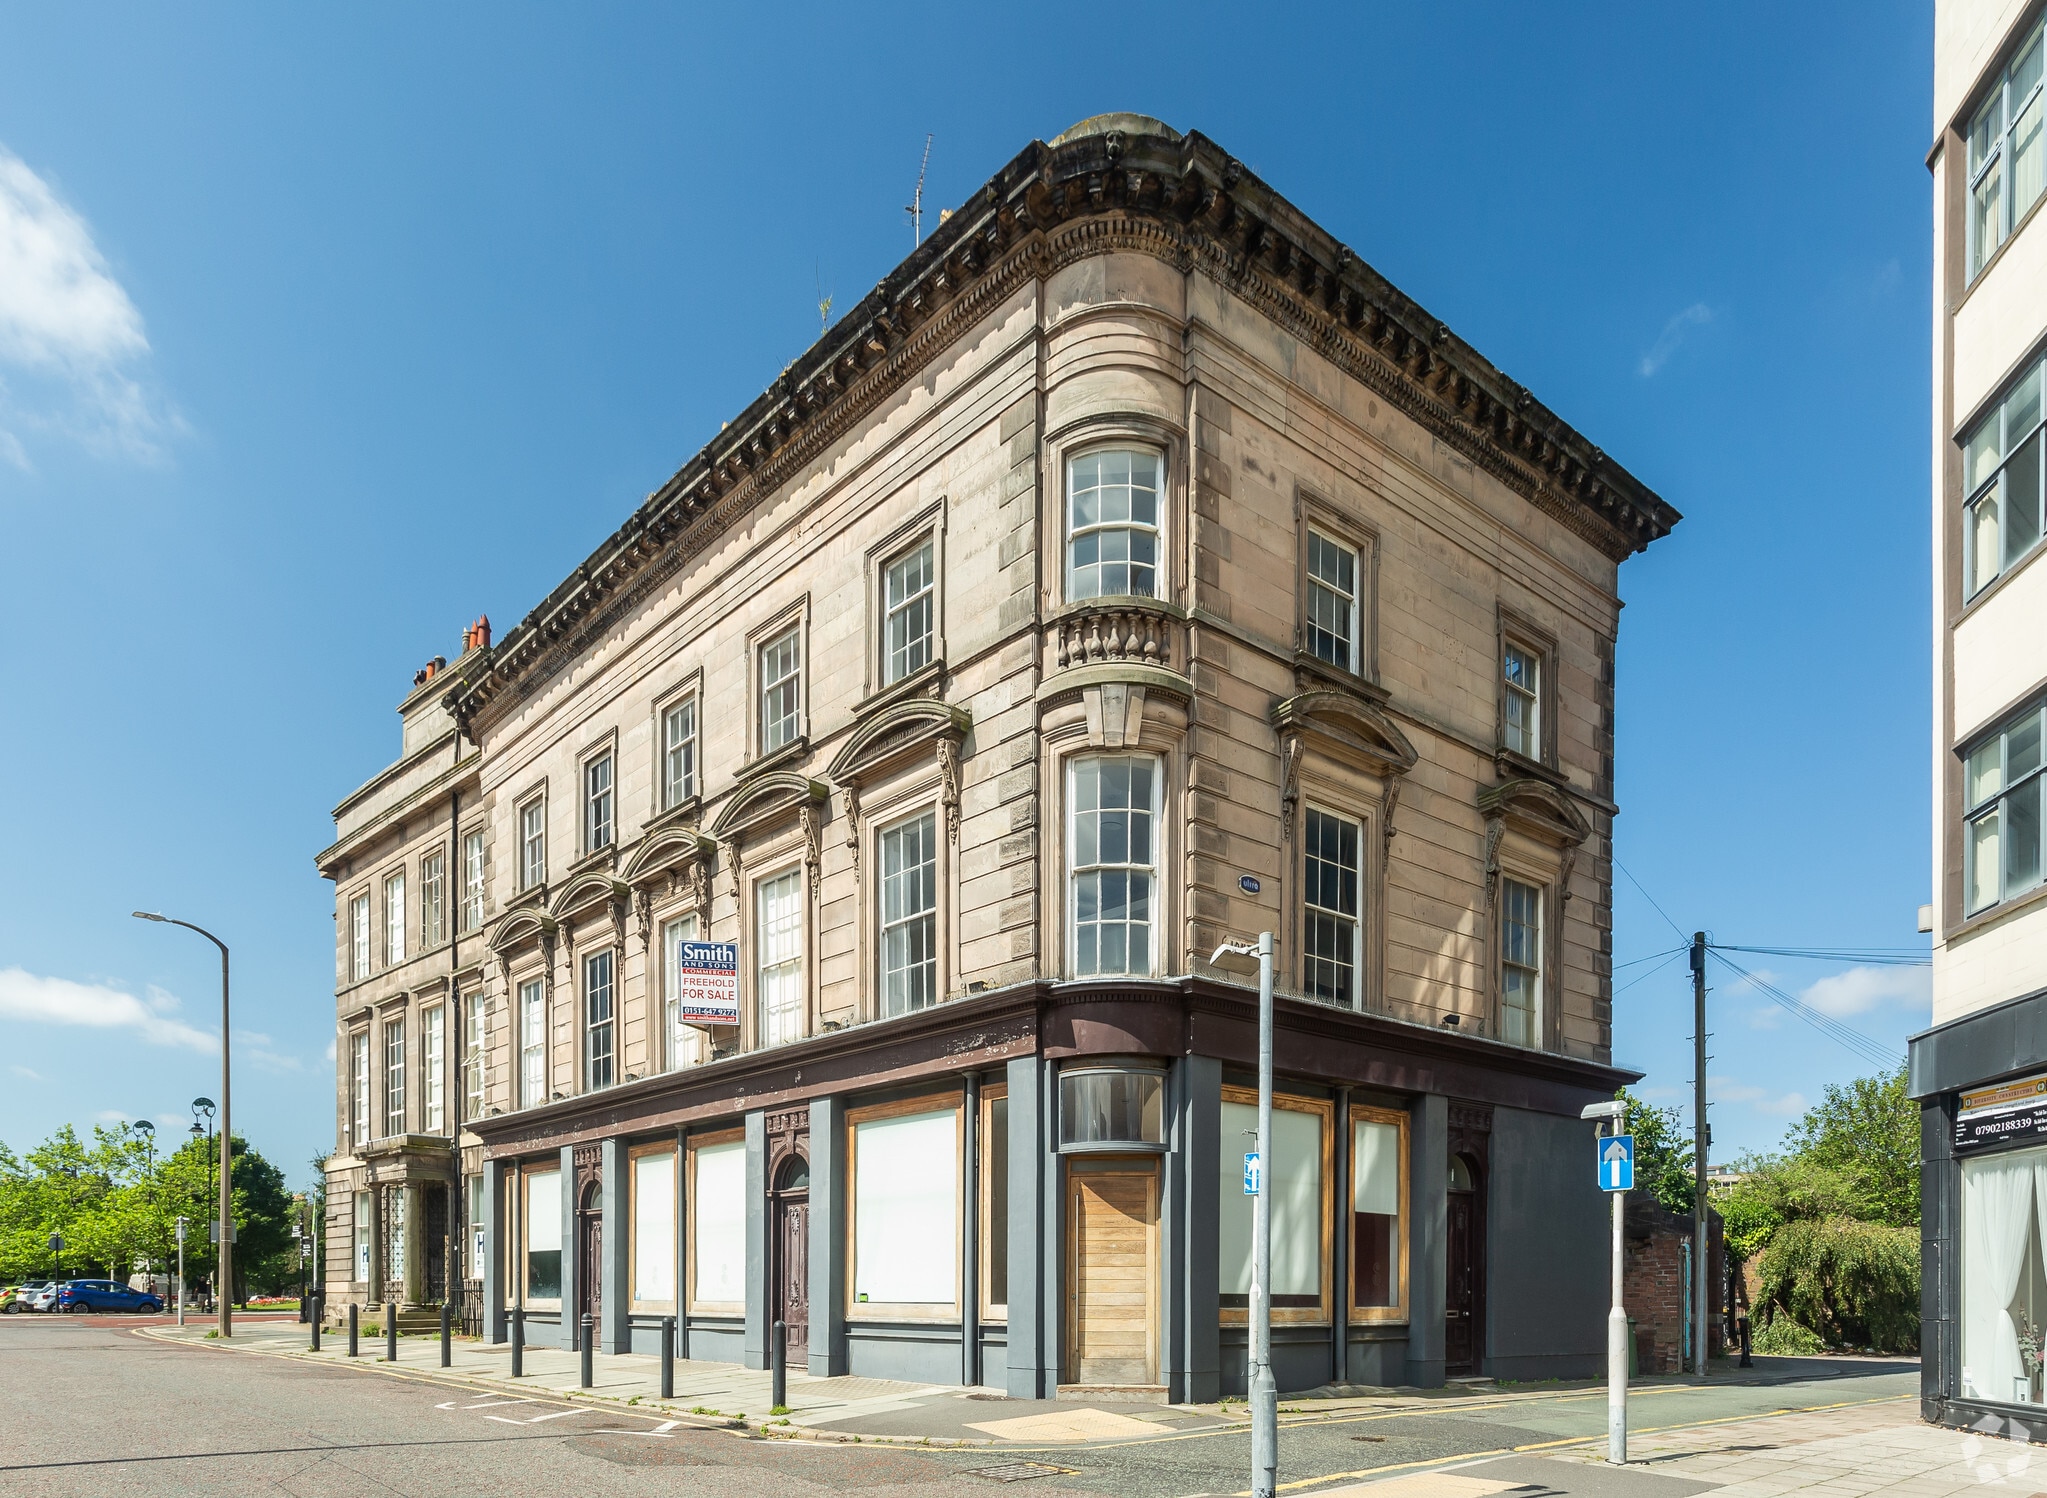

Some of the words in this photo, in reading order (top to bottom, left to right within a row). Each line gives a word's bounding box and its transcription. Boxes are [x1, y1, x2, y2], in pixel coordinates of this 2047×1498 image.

[684, 944, 733, 961] Smith
[684, 978, 734, 987] FREEHOLD
[683, 989, 704, 999] FOR
[708, 990, 734, 1000] SALE
[1975, 1118, 2032, 1135] 07902188339
